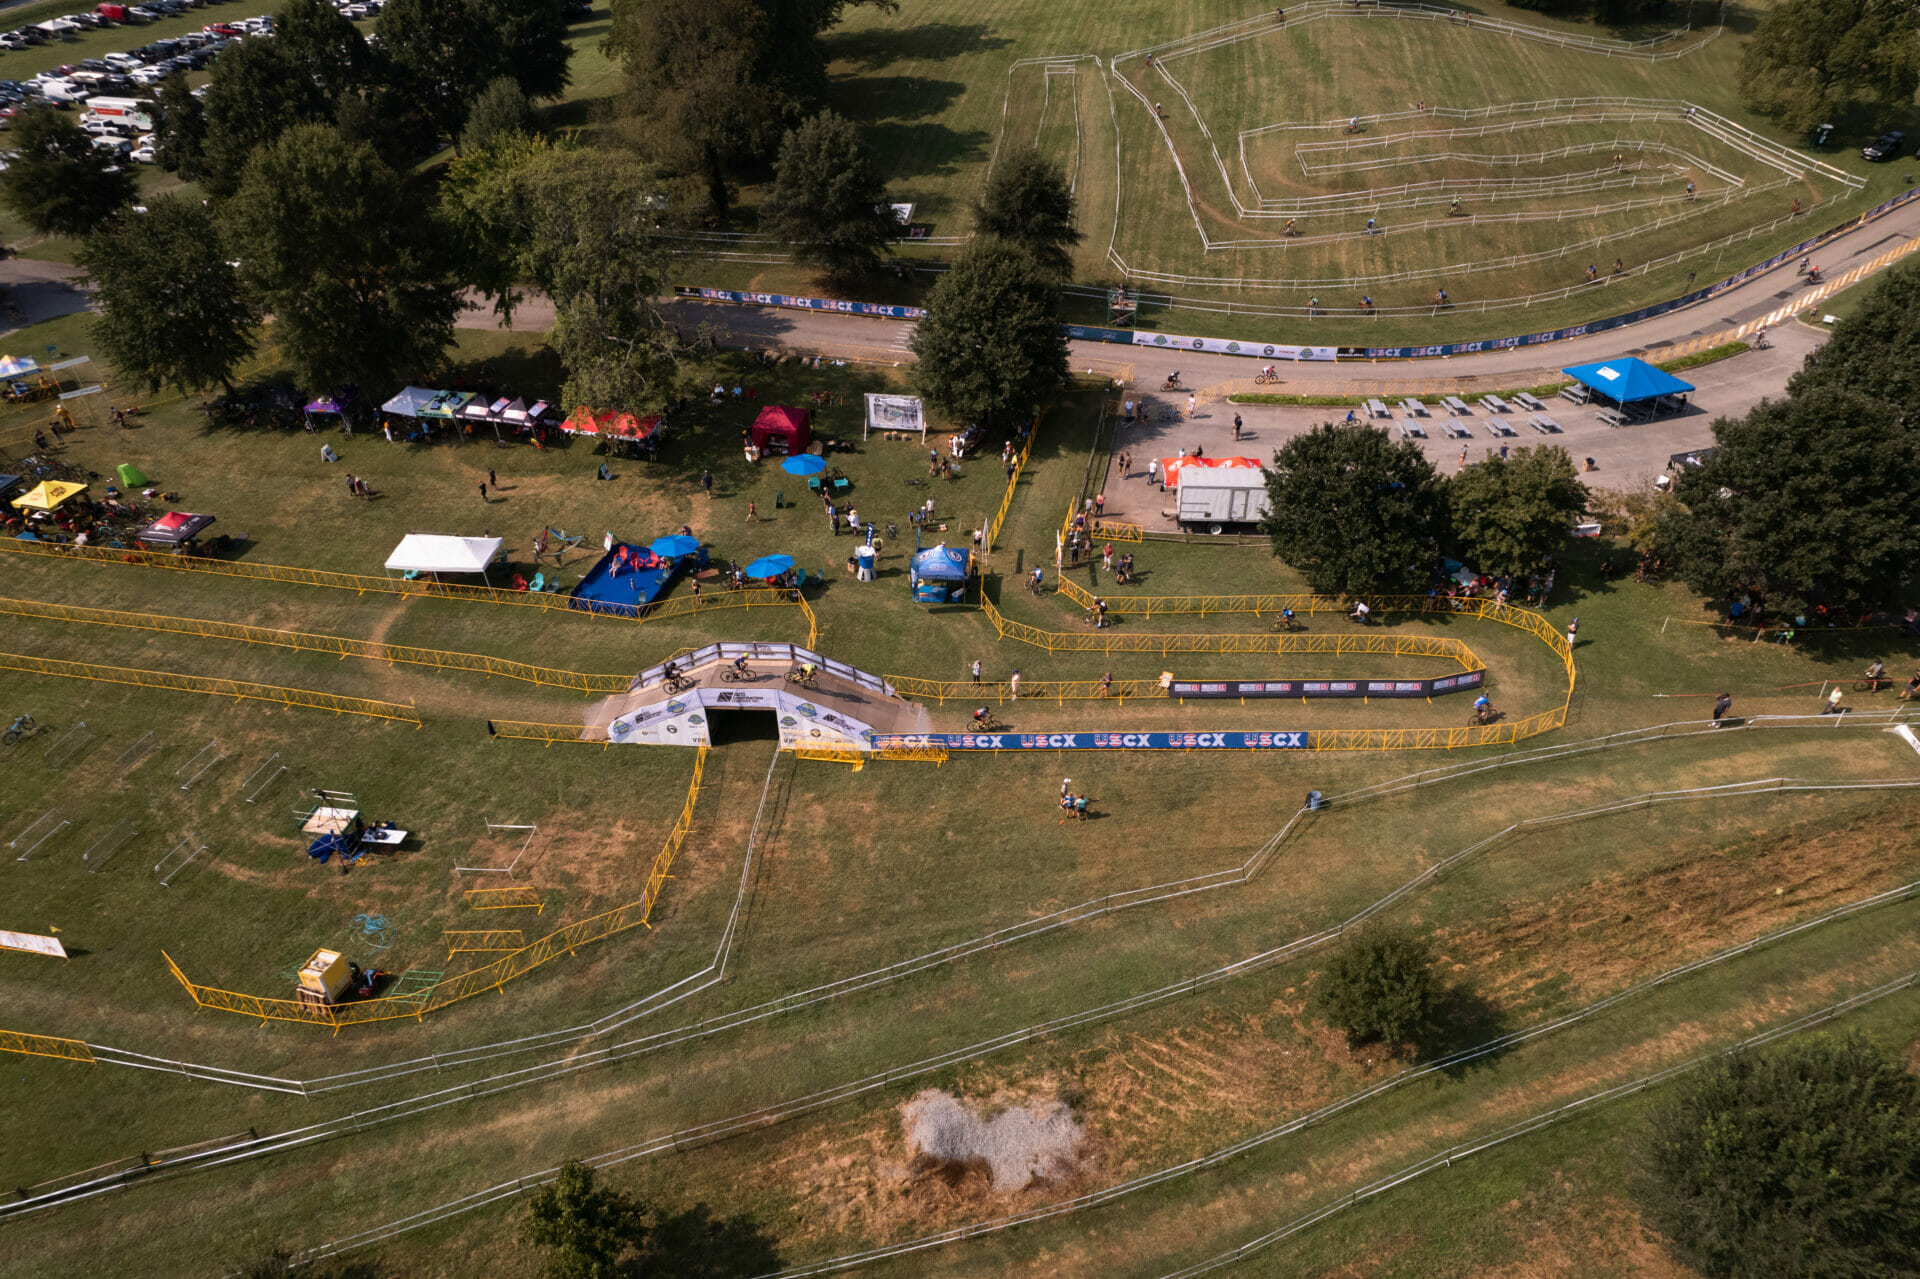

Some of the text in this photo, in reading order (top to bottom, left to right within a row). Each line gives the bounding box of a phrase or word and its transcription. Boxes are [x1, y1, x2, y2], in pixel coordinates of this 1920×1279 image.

[948, 735, 1003, 748] USCX
[1021, 734, 1076, 747] USCX
[1094, 734, 1151, 747] USCX
[1169, 733, 1226, 746] USCX
[1244, 733, 1302, 746] USCX
